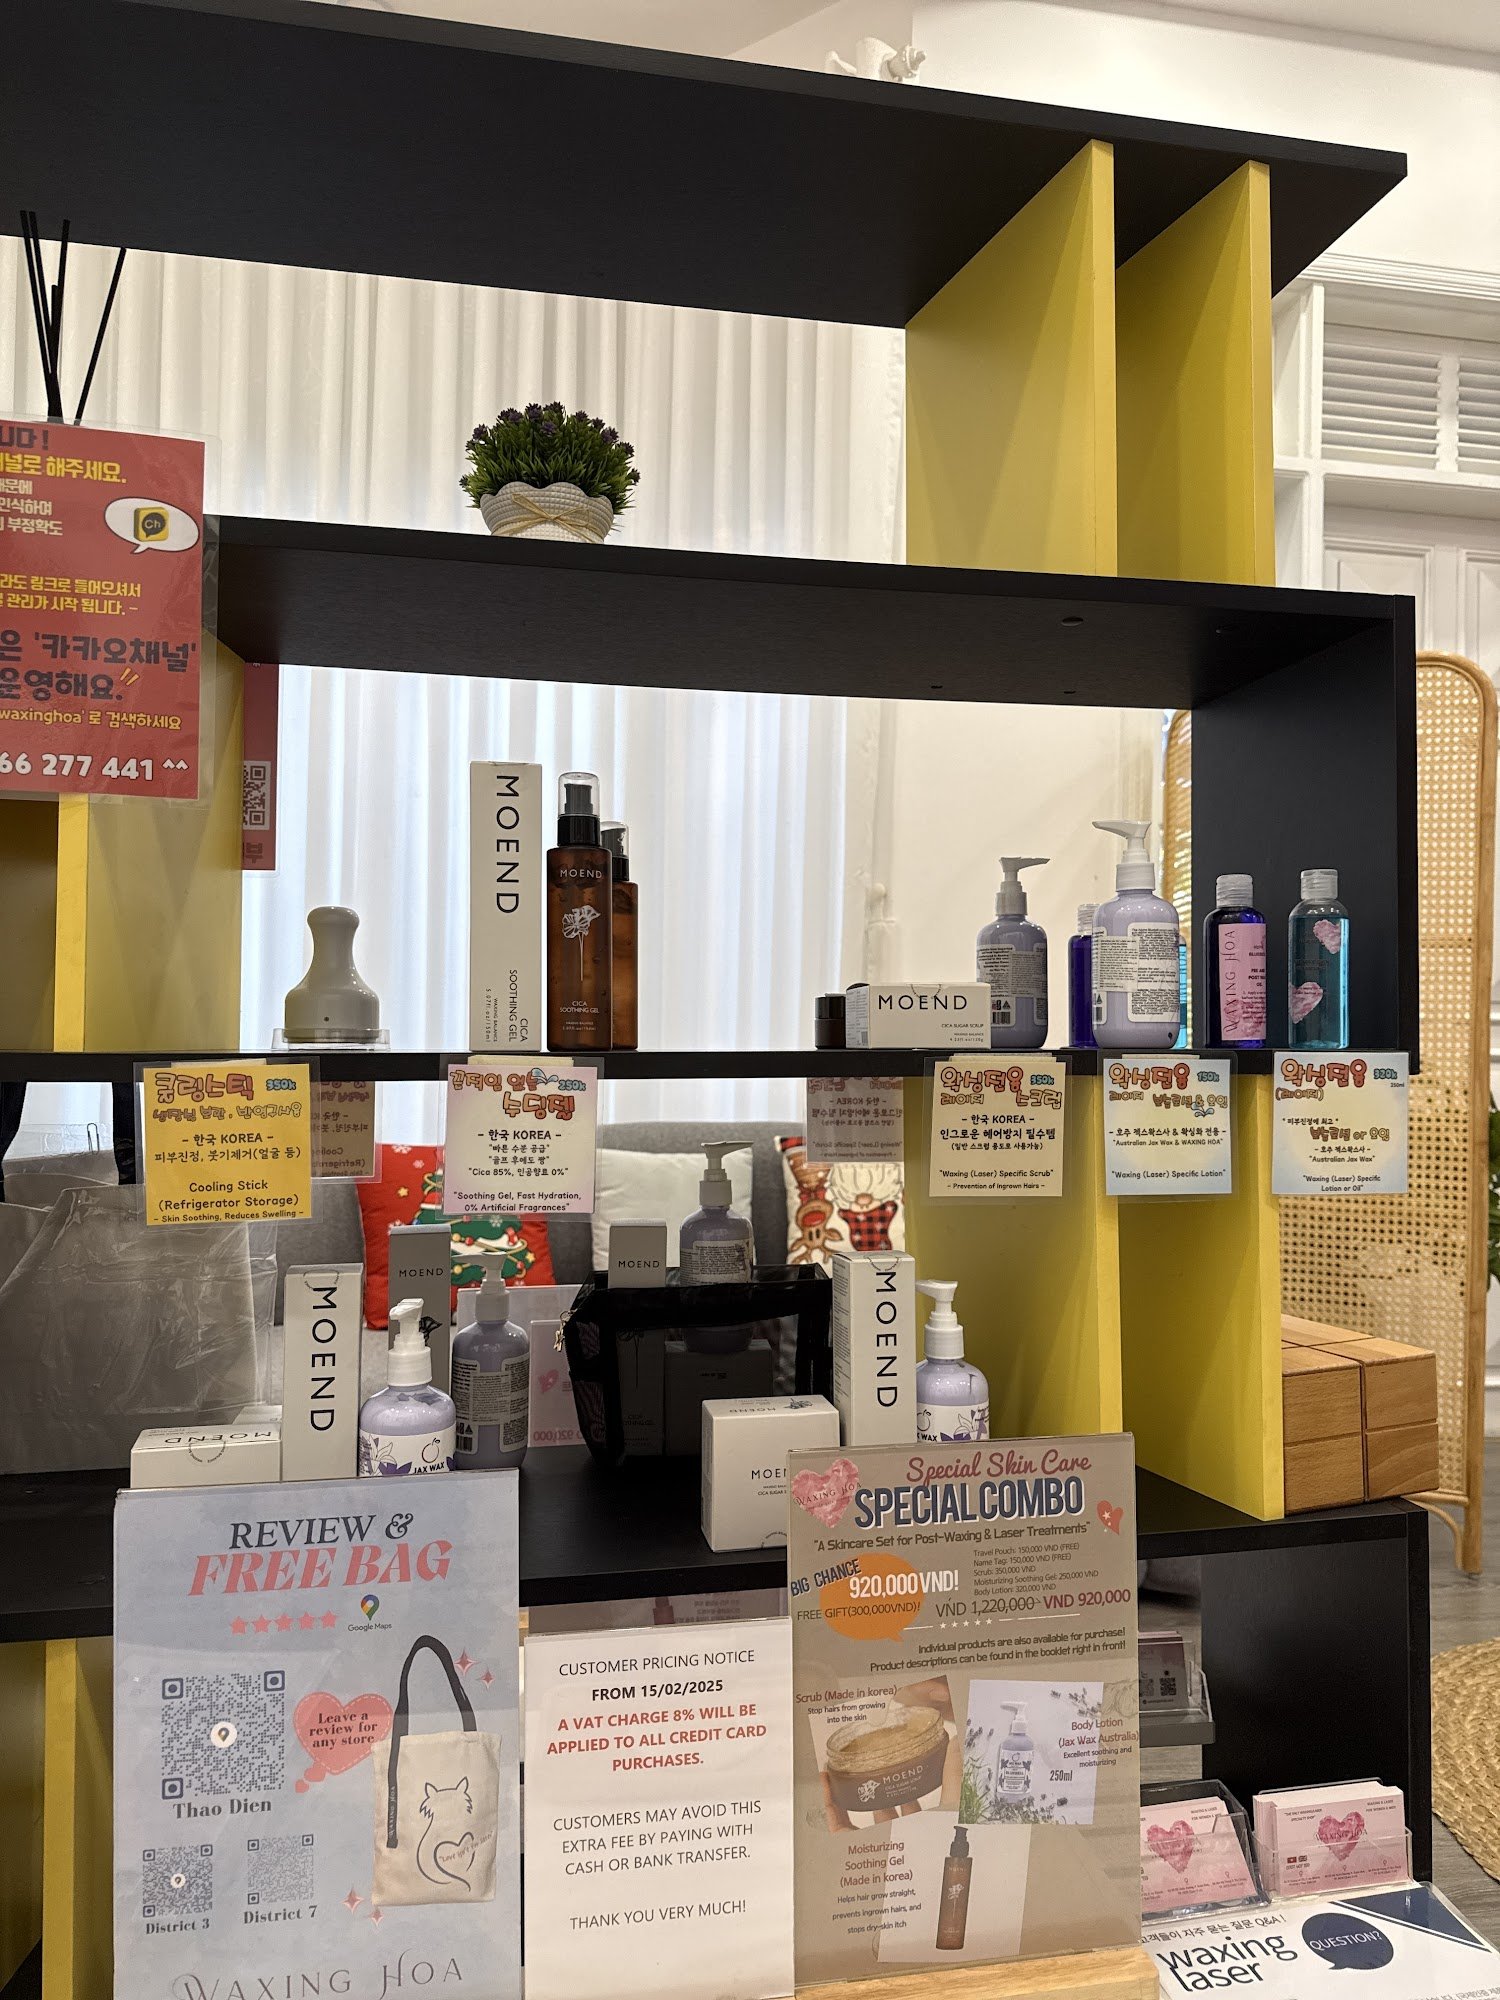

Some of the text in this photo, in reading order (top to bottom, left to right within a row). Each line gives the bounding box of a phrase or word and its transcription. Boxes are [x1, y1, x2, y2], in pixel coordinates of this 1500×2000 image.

[46, 455, 127, 483] 해주세요.
[144, 519, 161, 529] Ch
[31, 576, 71, 592] 링크로
[75, 578, 141, 598] 들어오셔서
[7, 593, 126, 615] 관리가 시작 됩니다.
[88, 711, 102, 725] 로
[106, 711, 182, 730] 검색하세요
[41, 753, 93, 777] 277
[102, 756, 154, 781] 441
[496, 775, 520, 914] MOEND
[560, 869, 602, 879] MOEND
[1221, 930, 1240, 1032] WAXING HOA
[509, 969, 518, 1042] SOOTHING GEL
[878, 994, 968, 1010] MOEND
[520, 1018, 528, 1042] CICA
[941, 1066, 1054, 1093] 왁싱전용 350k
[1109, 1062, 1220, 1090] 왁싱전용 150k
[1281, 1058, 1367, 1088] 왁싱전용
[155, 1072, 297, 1104] 쿨링스틱 350k
[972, 1115, 1026, 1126] 한국 KOREA
[194, 1133, 263, 1146] 한국 KOREA
[488, 1130, 552, 1141] 한국 KOREA
[940, 1128, 980, 1140] 인그로운
[983, 1128, 1022, 1140] 헤어방지
[155, 1151, 204, 1164] 피부진정,
[284, 1146, 301, 1159] 등)
[940, 1169, 968, 1178] "Waxing
[970, 1170, 997, 1178] (Laser)
[1000, 1170, 1028, 1178] Specific
[1143, 1170, 1170, 1178] (Laser)
[1172, 1170, 1198, 1178] Specific
[1200, 1169, 1226, 1177] Lotion"
[189, 1180, 268, 1194] Cooling Stick
[498, 1192, 514, 1200] Gel,
[517, 1192, 535, 1200] Fast
[538, 1192, 582, 1201] Hydration,
[159, 1194, 299, 1213] (Refrigerator Storage)
[464, 1204, 478, 1212] 0%
[480, 1204, 516, 1212] Artificial
[182, 1213, 222, 1222] Soothing,
[224, 1211, 260, 1220] Reduces
[262, 1210, 296, 1219] Swelling
[399, 1267, 444, 1278] MOEND
[618, 1259, 660, 1269] MOEND
[874, 1271, 898, 1408] MOEND
[310, 1285, 338, 1432] MOEND
[414, 1462, 445, 1474] JAX WAX
[906, 1449, 1092, 1487] Special Skin Care
[854, 1476, 1086, 1530] SPECIAL COMBO
[229, 1513, 414, 1550] REVIEW &
[828, 1536, 874, 1550] Skincare
[876, 1535, 894, 1548] Set
[896, 1534, 912, 1546] for
[915, 1530, 982, 1546] Post-Waxing
[984, 1528, 992, 1540] &
[994, 1527, 1025, 1539] Laser
[1027, 1522, 1090, 1536] Treatments"
[188, 1540, 454, 1597] FREE BAG
[791, 1558, 862, 1598] BIG CHANCE
[1043, 1589, 1131, 1610] VND 920,000
[348, 1622, 392, 1633] Google Maps
[559, 1650, 755, 1677] CUSTOMER PRICING NOTICE
[592, 1680, 724, 1702] FROM 15/02/2025
[796, 1685, 898, 1704] Scrub (Made in korea)
[318, 1712, 368, 1724] Leave a
[558, 1704, 757, 1732] A VAT CHARGE 8% WILL BE
[1072, 1718, 1123, 1732] Body Lotion
[309, 1722, 378, 1736] review for
[547, 1724, 767, 1755] APPLIED TO ALL CREDIT CARD
[312, 1734, 375, 1750] any store
[612, 1754, 704, 1772] PURCHASES.
[173, 1799, 272, 1820] Thao Dien
[848, 1841, 904, 1856] Moisturizing
[845, 1856, 904, 1870] Soothing Gel
[244, 1906, 318, 1924] District 7
[570, 1900, 746, 1930] THANK YOU VERY MUCH!
[145, 1918, 210, 1936] District 3
[1309, 1930, 1382, 1951] QUESTION?
[1157, 1934, 1298, 1970] waxing
[172, 1948, 463, 2000] WAXING HOA
[1168, 1960, 1265, 1992] laser
